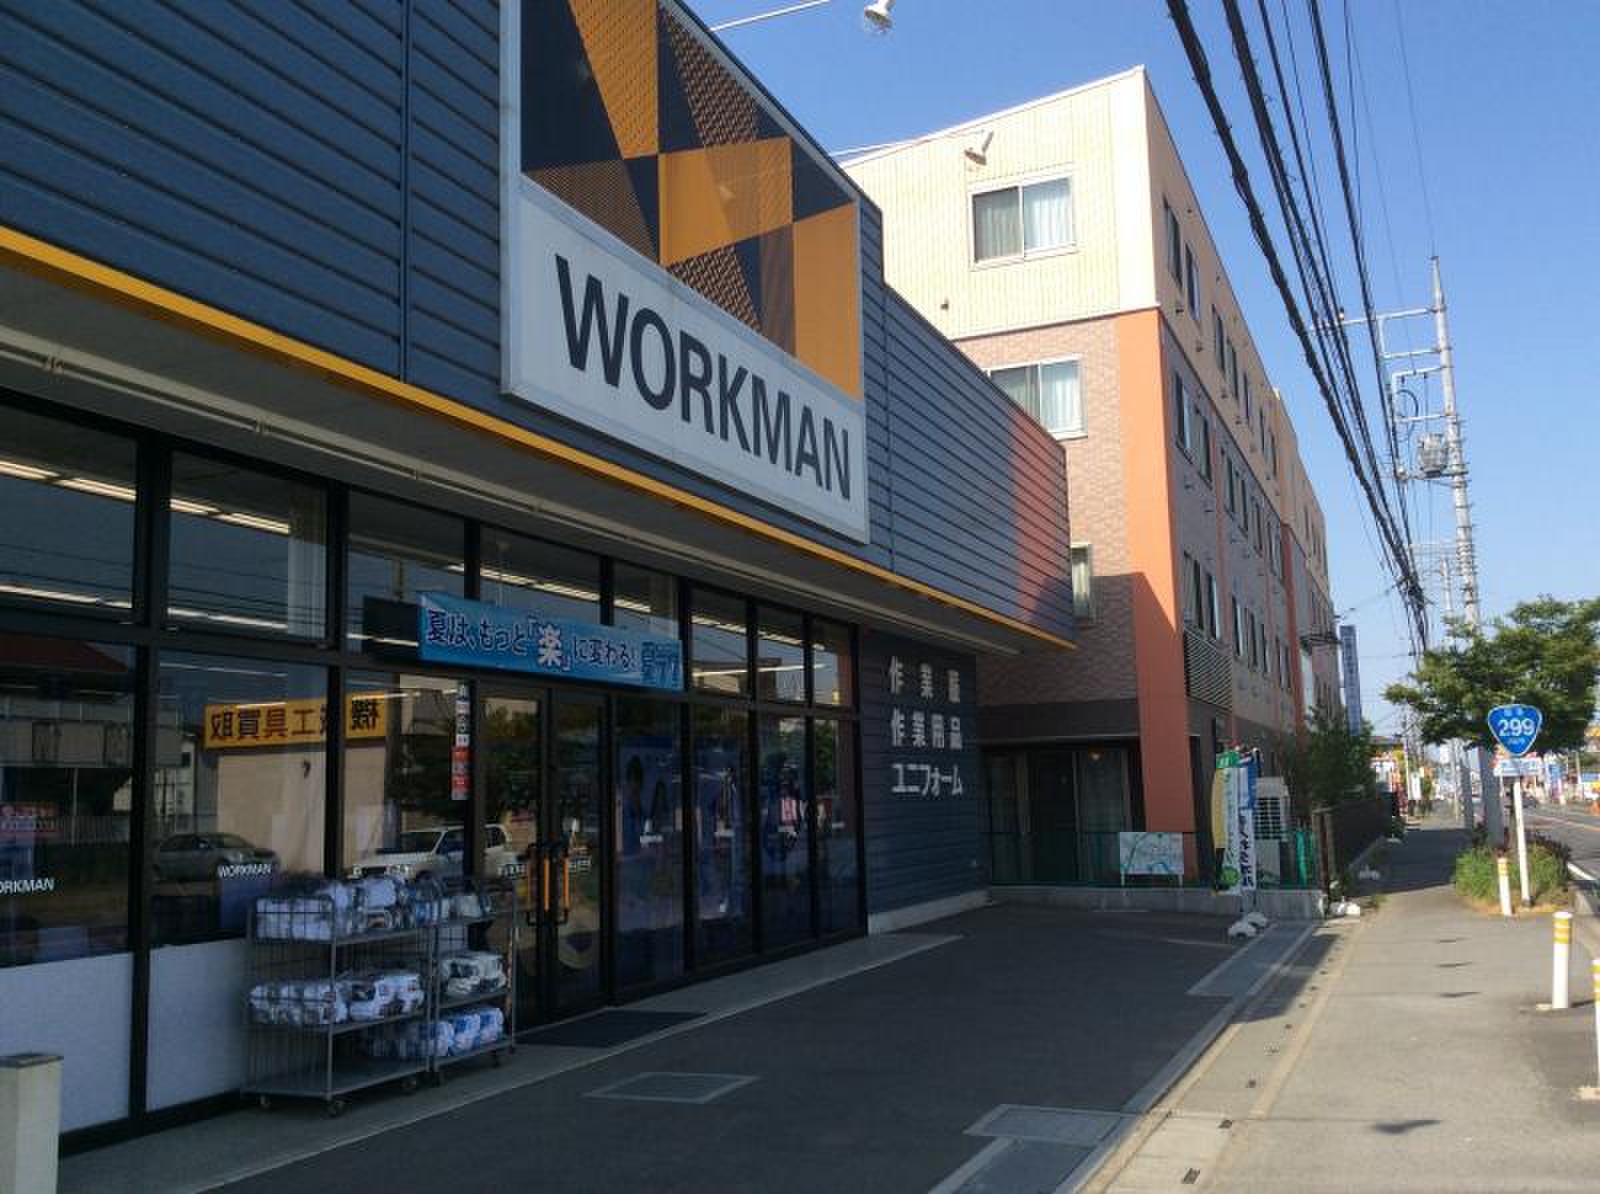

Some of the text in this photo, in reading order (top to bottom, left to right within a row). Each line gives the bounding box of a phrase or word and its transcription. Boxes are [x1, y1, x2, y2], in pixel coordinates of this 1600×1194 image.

[555, 253, 850, 501] WORKMAN
[1498, 718, 1534, 736] 299
[891, 763, 963, 796] ユニフォーム
